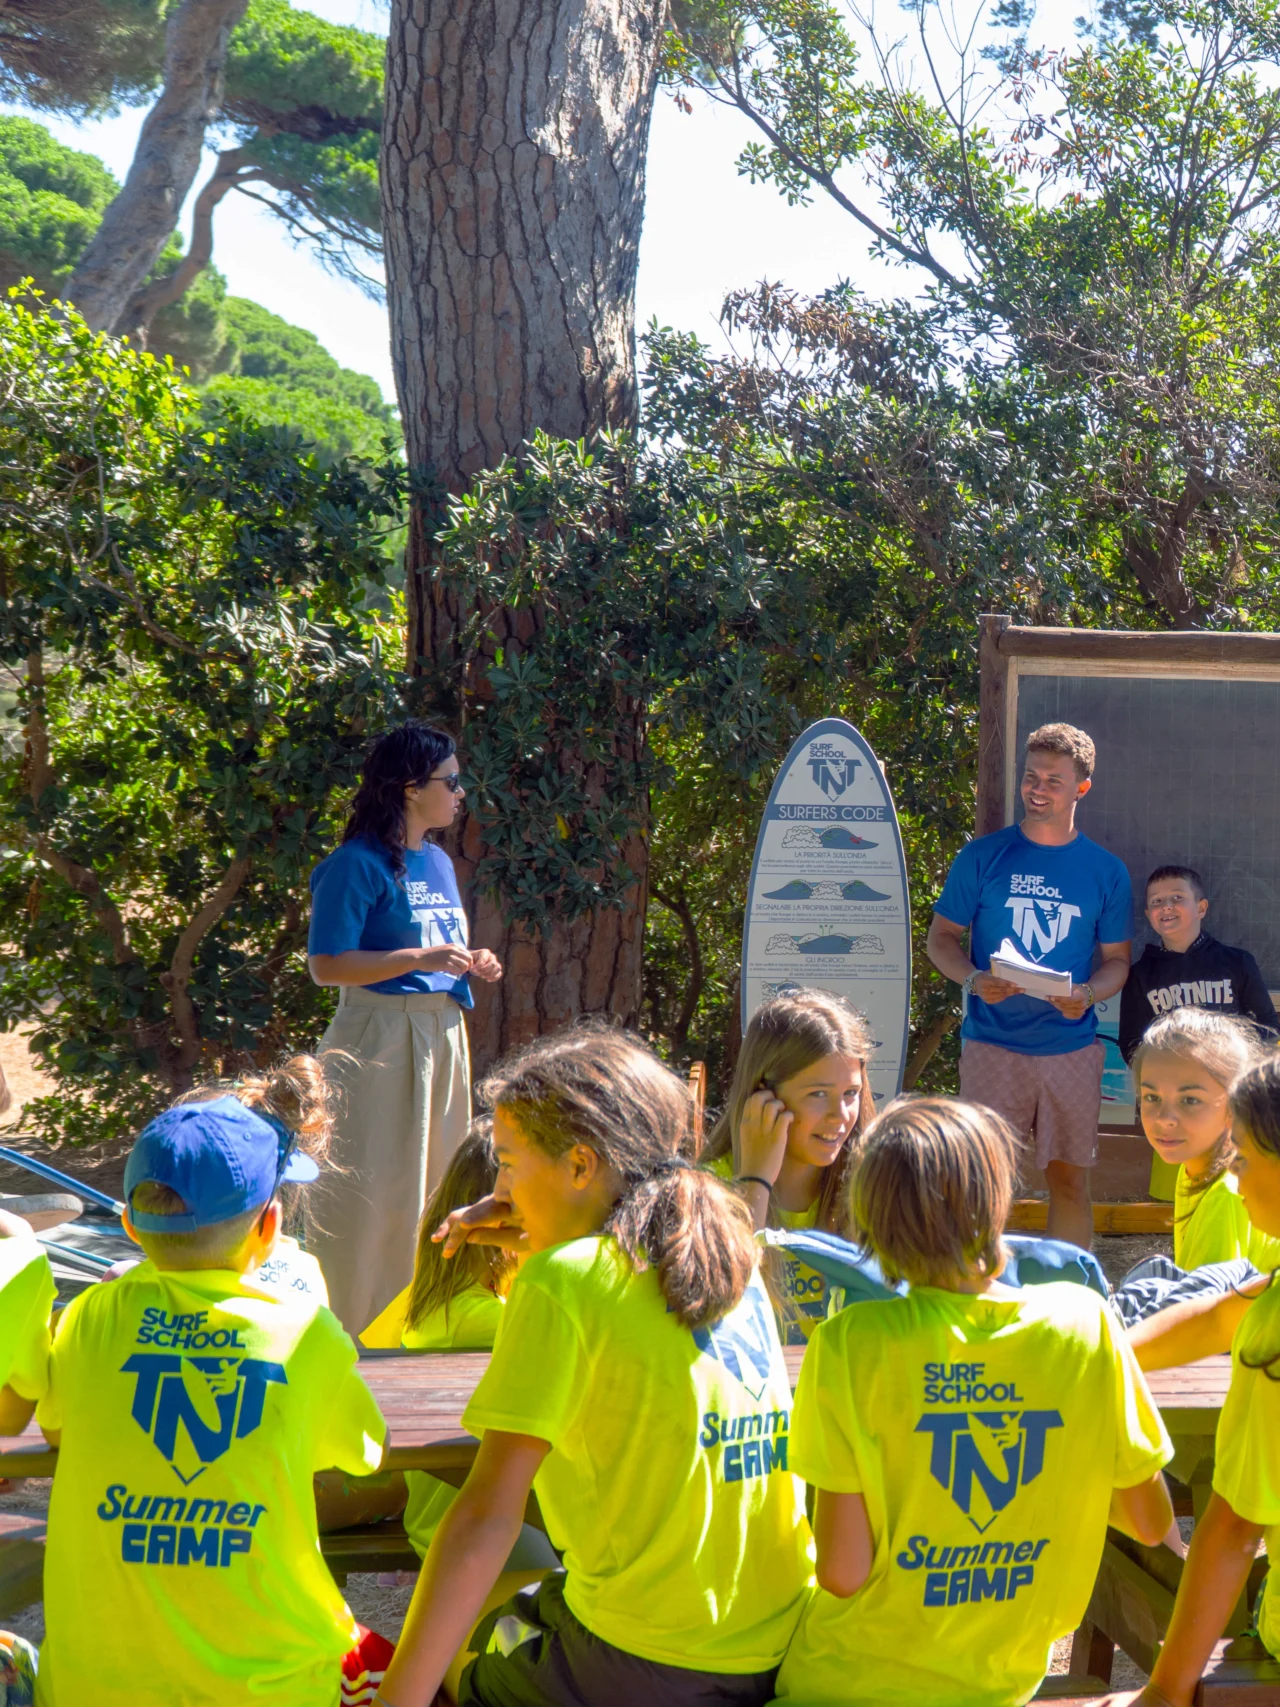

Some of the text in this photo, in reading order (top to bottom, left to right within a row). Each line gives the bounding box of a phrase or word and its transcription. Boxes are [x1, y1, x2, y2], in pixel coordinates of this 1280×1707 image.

[810, 743, 833, 751] SURF
[806, 758, 862, 796] TNT
[778, 805, 884, 820] SURFERS CODE
[1009, 884, 1063, 899] SCHOOL
[1010, 874, 1044, 886] SURF
[755, 903, 792, 911] SEGNALARE
[1004, 897, 1081, 953] TNT
[805, 956, 845, 964] GLI INCROCI
[1146, 978, 1233, 1015] FORTNITE
[141, 1306, 208, 1331] SURF
[136, 1326, 246, 1350] SCHOOL
[923, 1363, 985, 1382] SURF
[119, 1353, 288, 1464] TNT
[923, 1383, 1024, 1404] SCHOOL
[724, 1436, 789, 1483] CAM
[913, 1409, 1064, 1514] TNT
[96, 1484, 268, 1527] Summer
[122, 1523, 252, 1568] CAMP
[896, 1535, 1050, 1571] Summer
[923, 1565, 1034, 1607] CAMP
